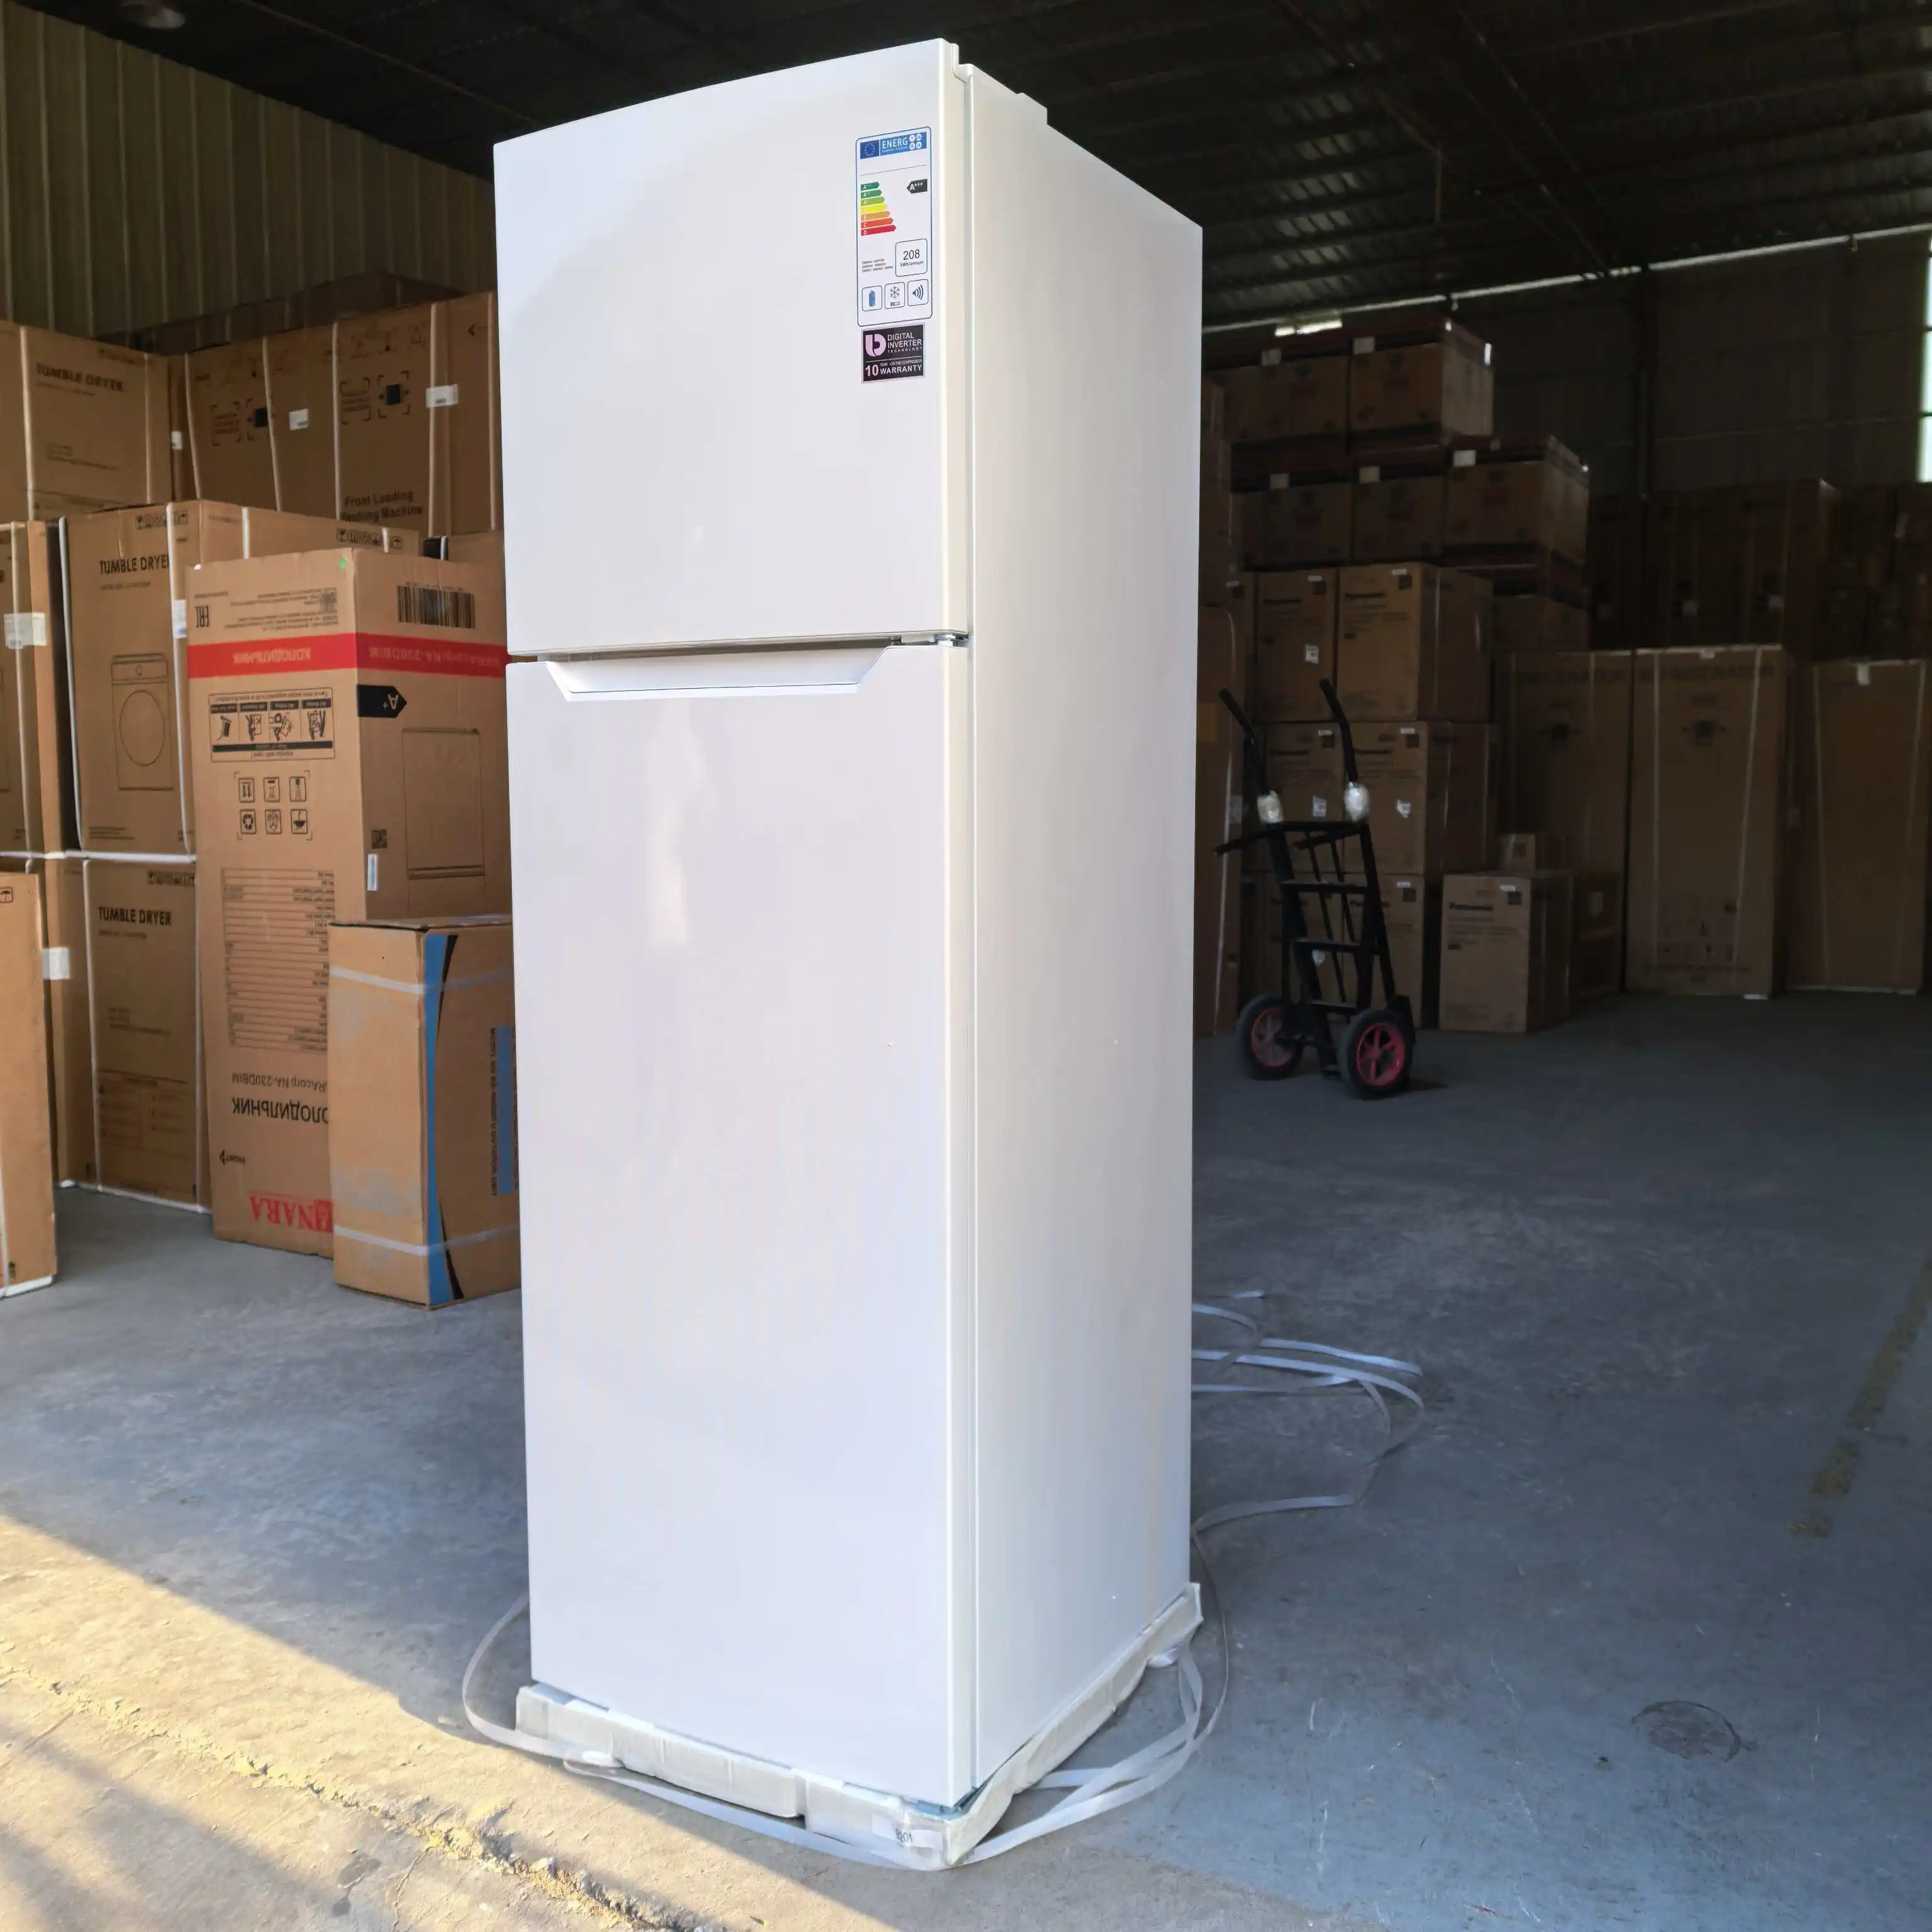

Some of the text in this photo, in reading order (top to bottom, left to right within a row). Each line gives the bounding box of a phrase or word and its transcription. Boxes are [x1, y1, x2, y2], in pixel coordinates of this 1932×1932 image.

[882, 136, 909, 150] ENERG
[902, 249, 921, 260] 208
[887, 332, 914, 342] DIGITAL
[887, 338, 923, 349] INVERTER
[865, 364, 879, 377] 10
[880, 364, 923, 375] WARRANTY
[381, 505, 423, 519] Machine
[99, 557, 137, 575] TUMBLE
[97, 906, 172, 926] TUMBLE DRYER
[290, 1076, 328, 1093] RAcorp
[231, 1097, 329, 1125] ОЛОДИЛЬНИК
